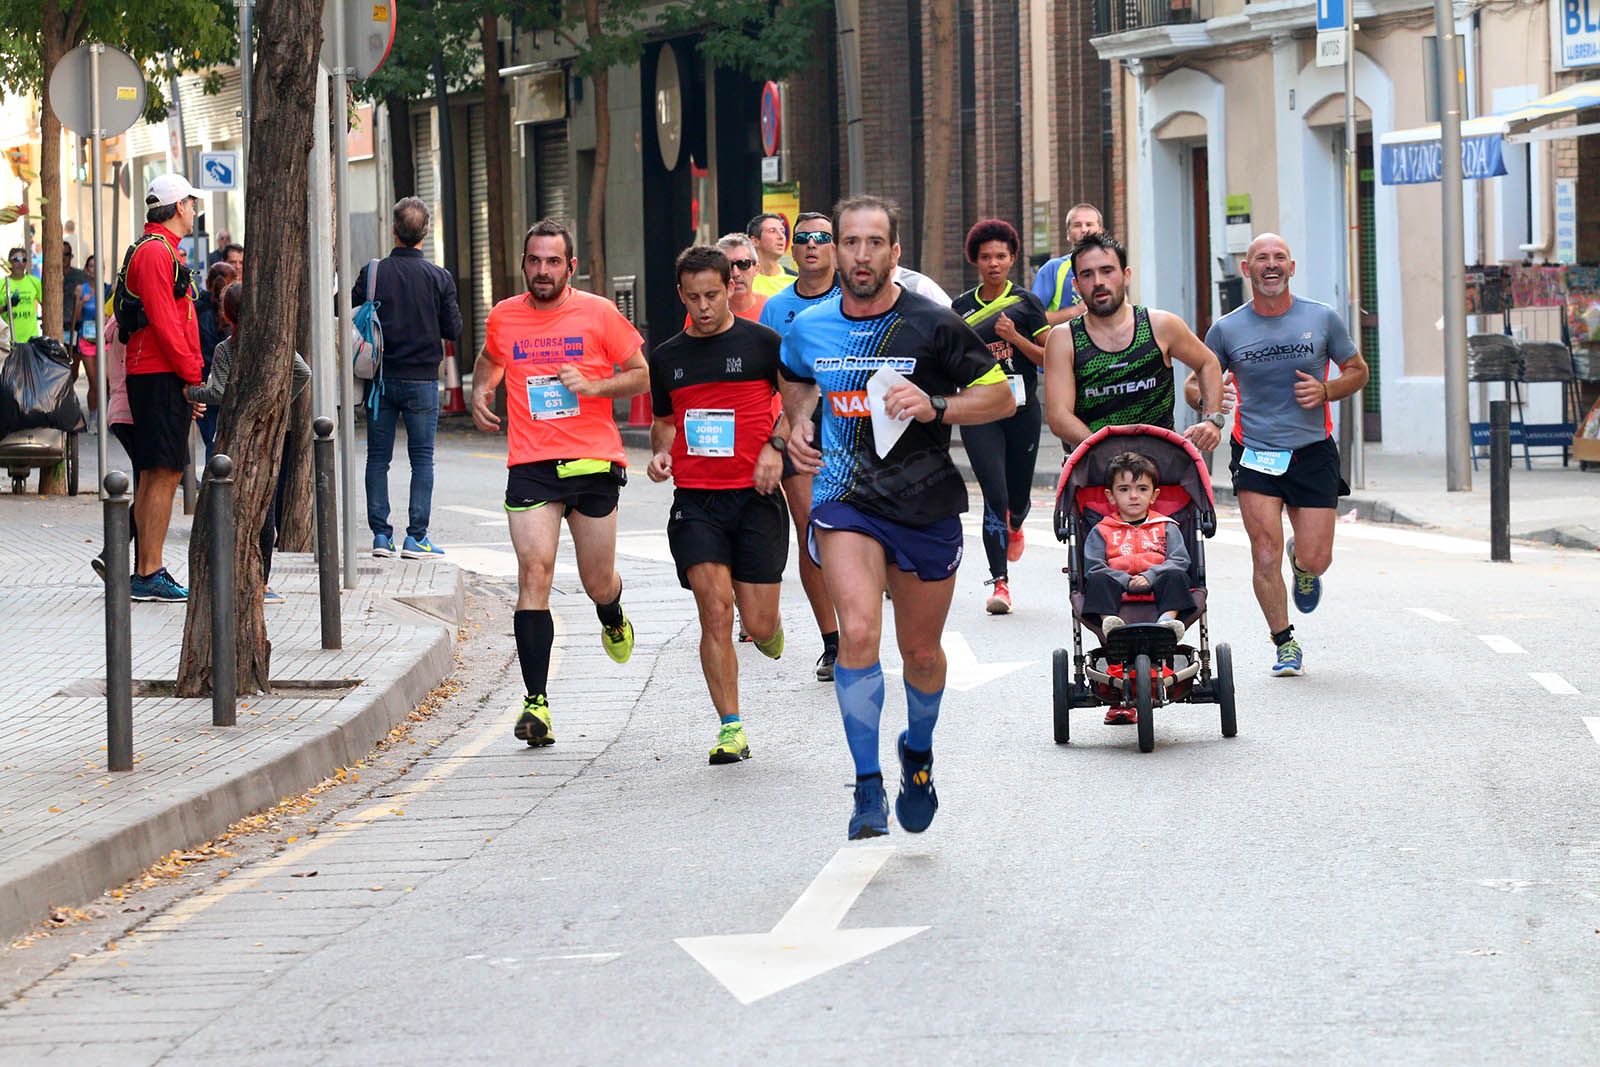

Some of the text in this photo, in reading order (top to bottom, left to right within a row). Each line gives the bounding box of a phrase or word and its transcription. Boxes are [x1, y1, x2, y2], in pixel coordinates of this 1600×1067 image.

[534, 337, 563, 348] CURSA
[815, 359, 841, 370] Fun
[1085, 377, 1157, 398] RUNTEAM
[543, 391, 562, 399] POL
[695, 425, 723, 435] JORDI
